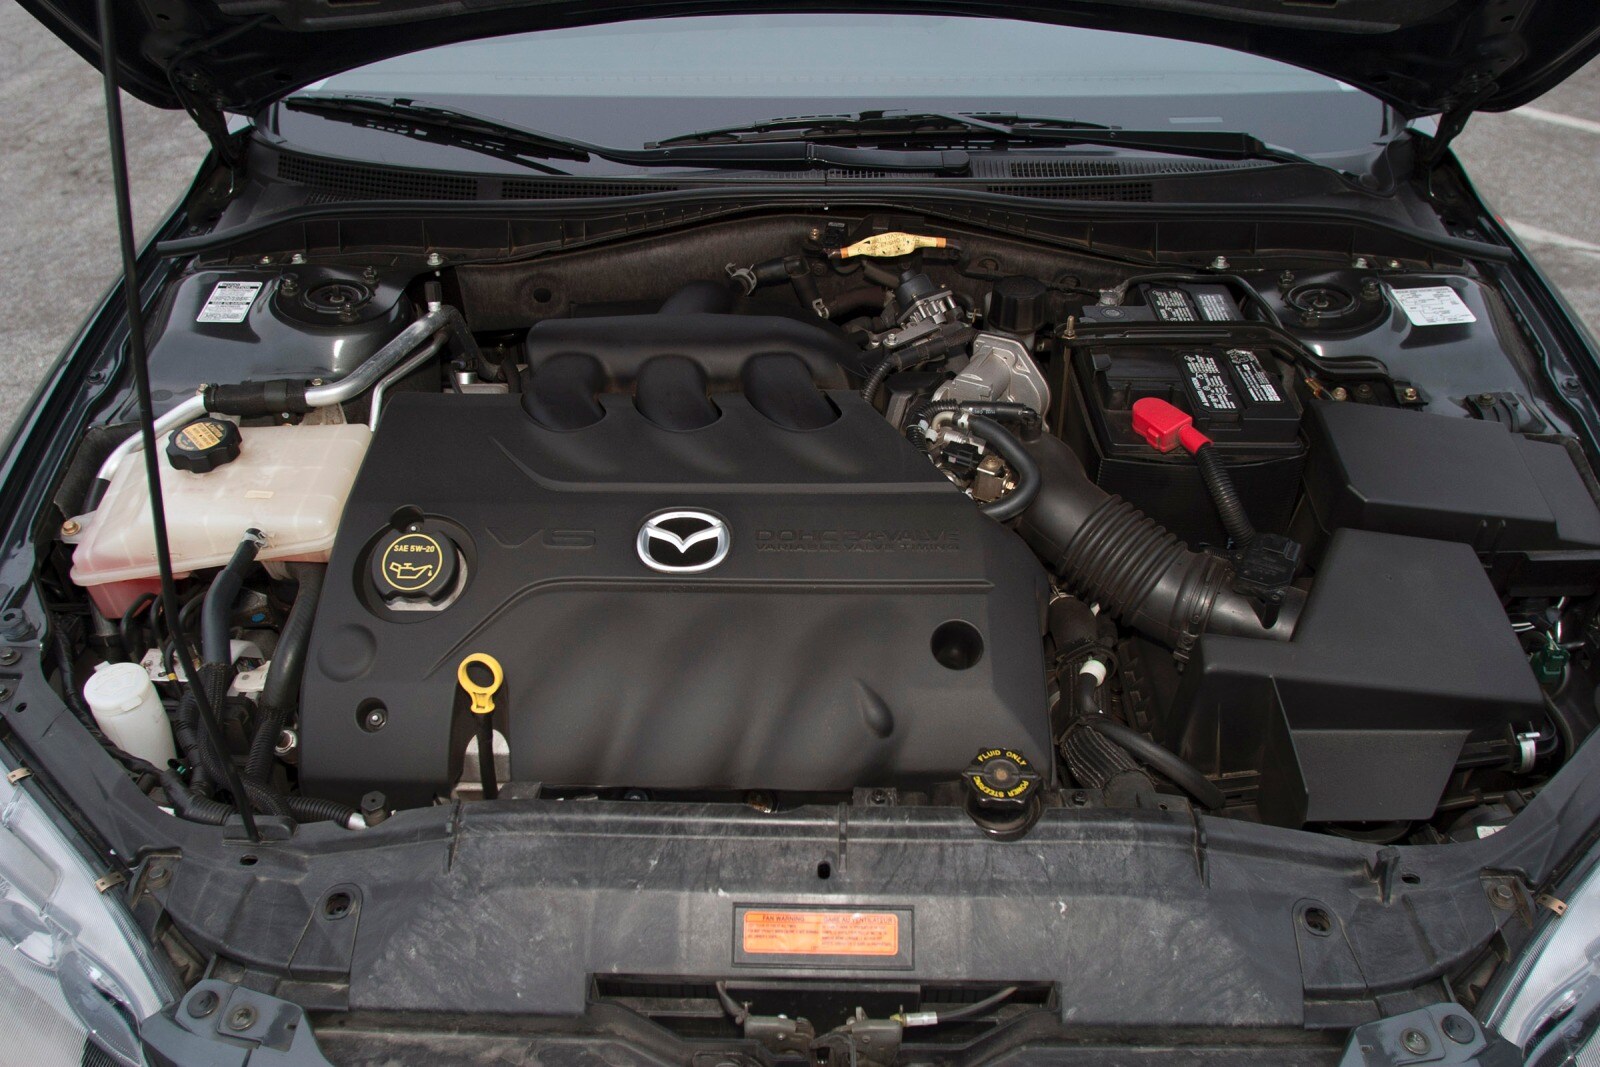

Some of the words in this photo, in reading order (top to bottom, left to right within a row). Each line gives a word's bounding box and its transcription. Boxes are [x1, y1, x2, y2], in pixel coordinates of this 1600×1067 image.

[485, 528, 596, 549] V6
[393, 544, 409, 553] SAE
[410, 544, 436, 553] 5W-20
[977, 749, 1001, 761] FLUID
[1006, 751, 1027, 766] ONLY
[1007, 780, 1029, 797] POWER
